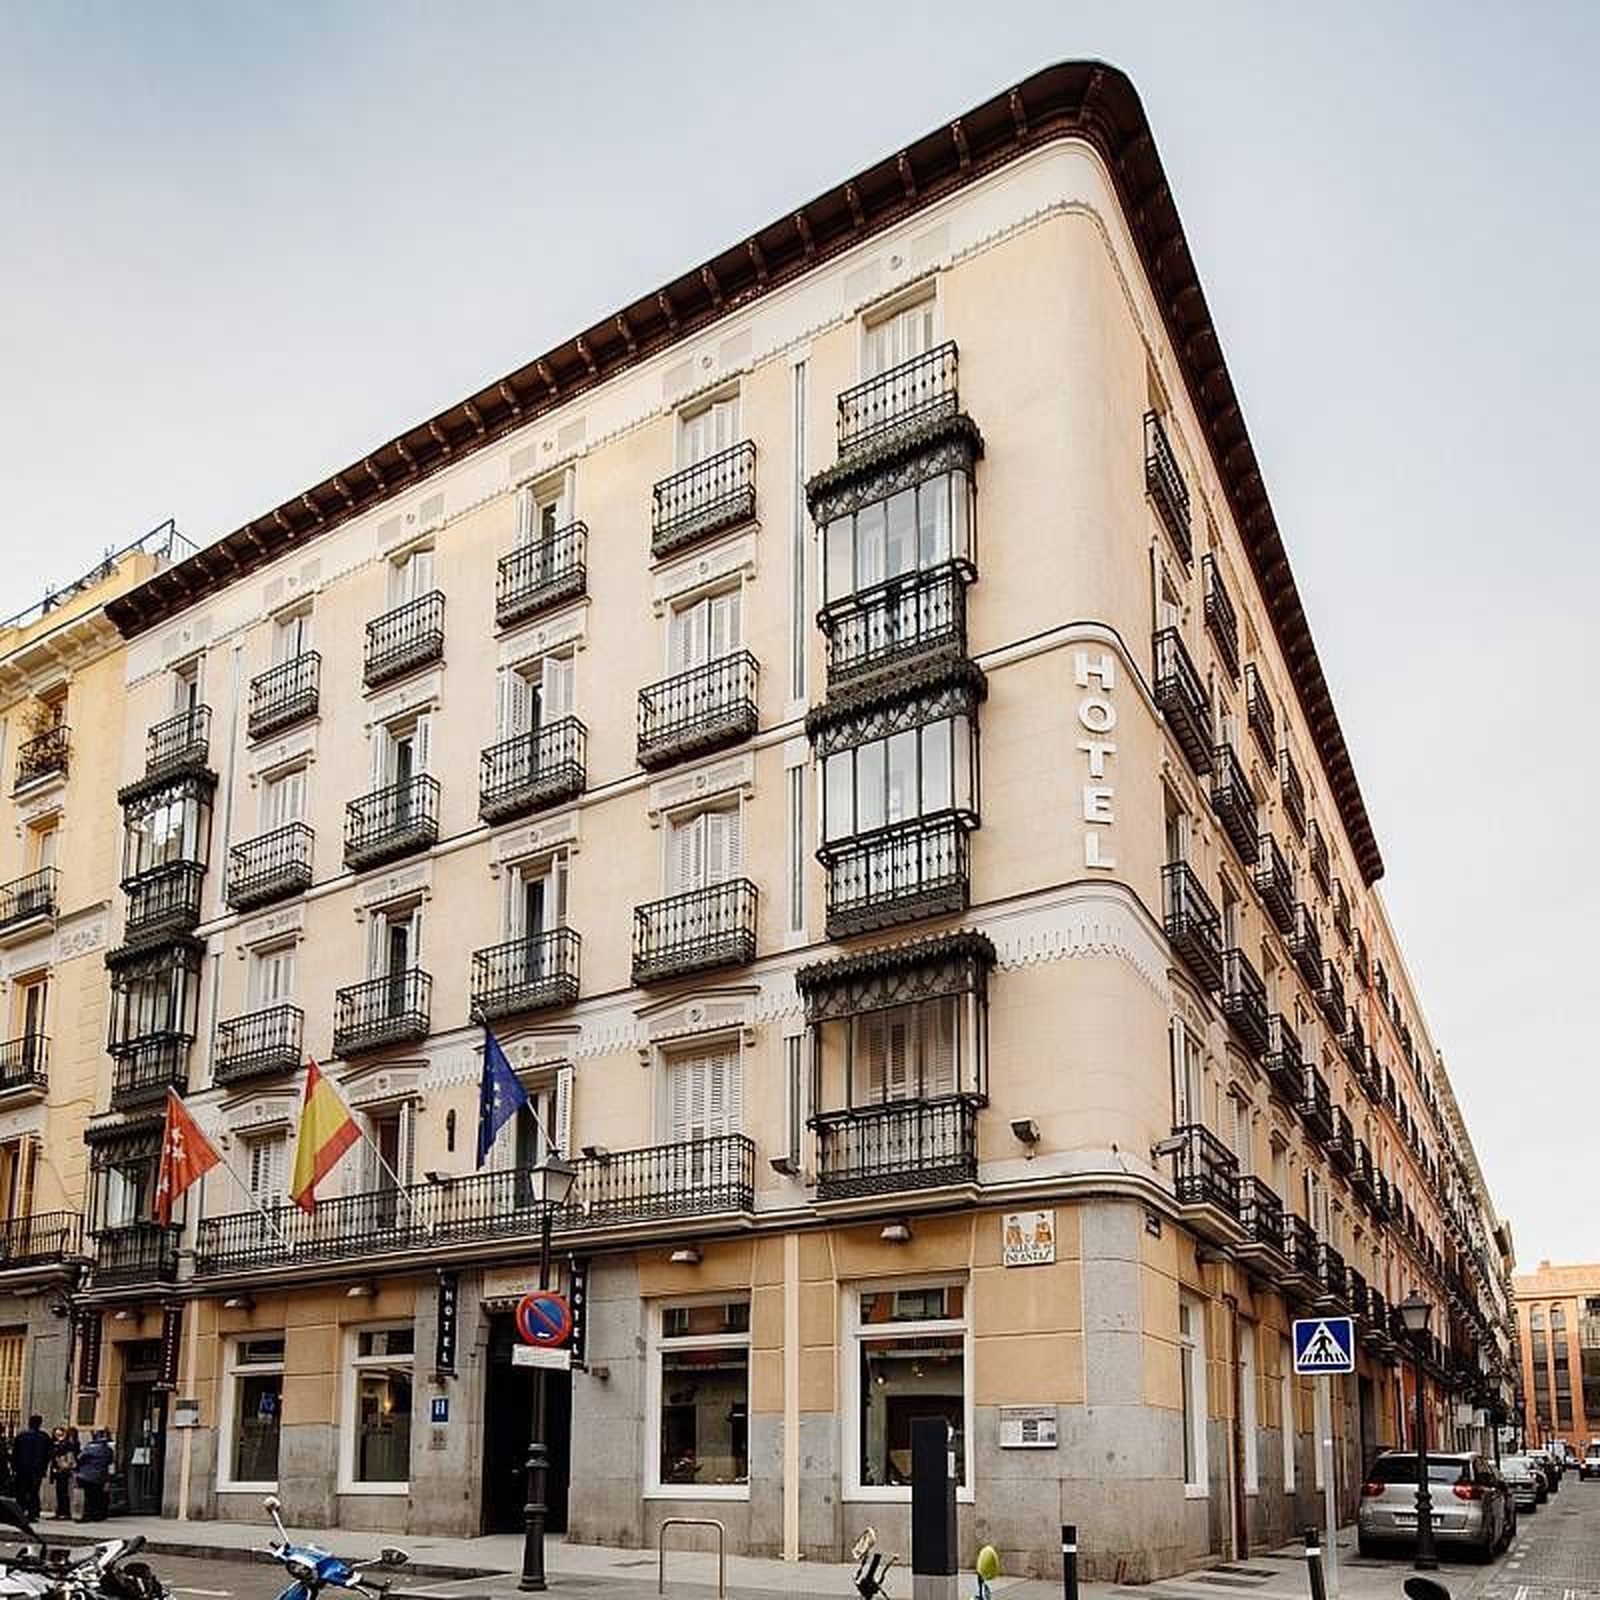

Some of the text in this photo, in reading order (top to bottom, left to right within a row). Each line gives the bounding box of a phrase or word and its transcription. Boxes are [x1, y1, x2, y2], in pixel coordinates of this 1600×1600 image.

[1074, 653, 1117, 870] HOTEL
[442, 1289, 453, 1363] HOTEL
[573, 1277, 582, 1355] HOTEL
